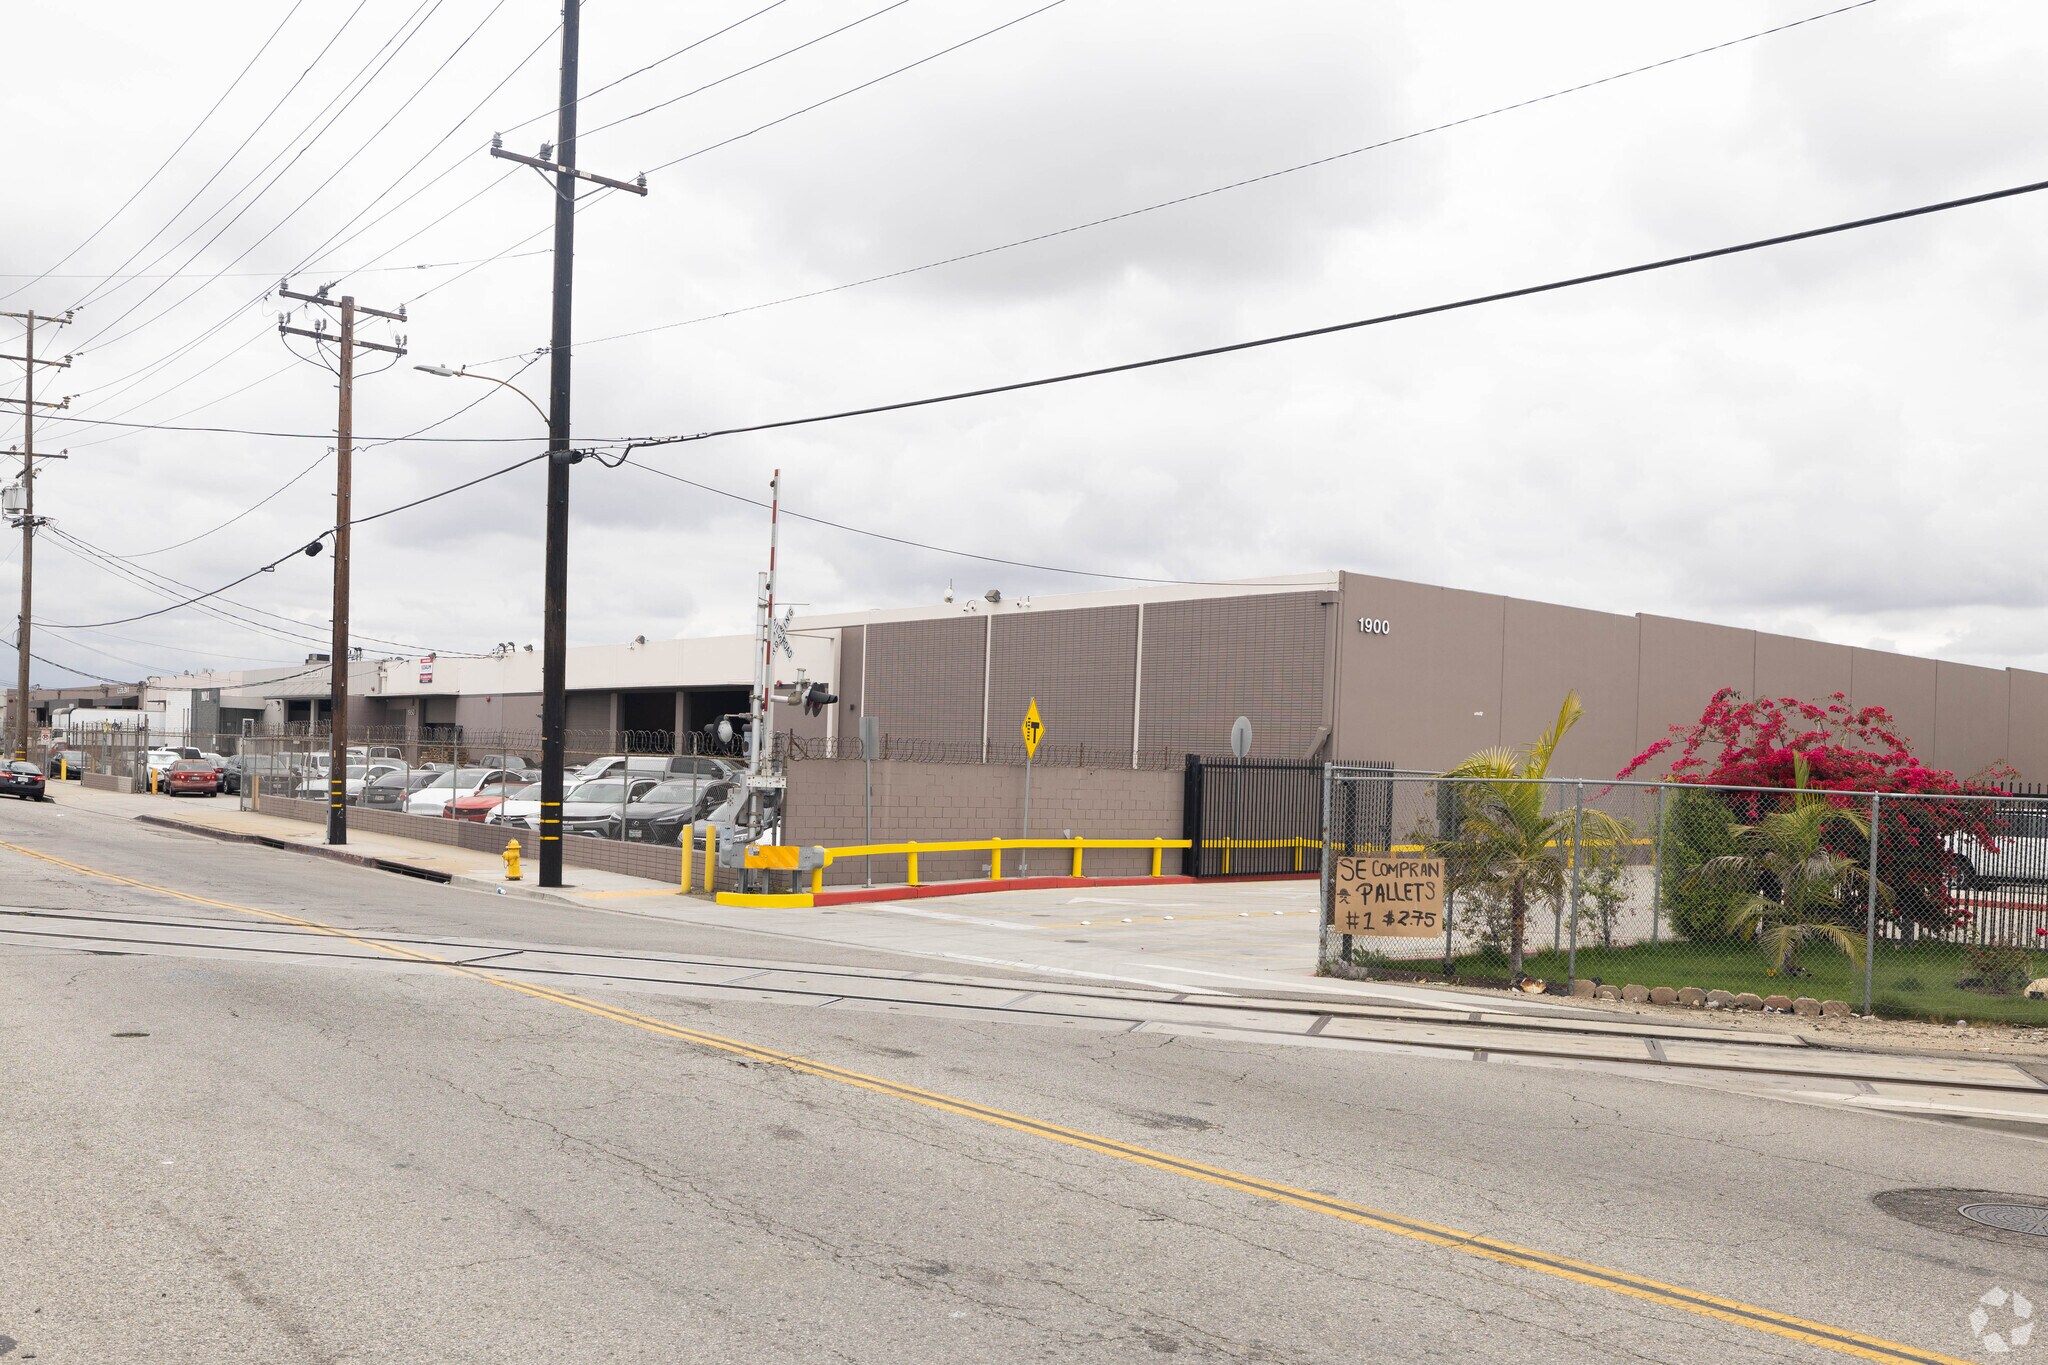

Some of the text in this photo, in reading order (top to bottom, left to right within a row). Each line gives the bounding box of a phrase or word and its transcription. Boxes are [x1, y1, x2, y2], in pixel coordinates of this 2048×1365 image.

[1358, 617, 1390, 635] 1900
[1339, 858, 1440, 881] SE COMPRAN
[1355, 881, 1436, 905] PALLETS
[1382, 910, 1437, 928] $2.75
